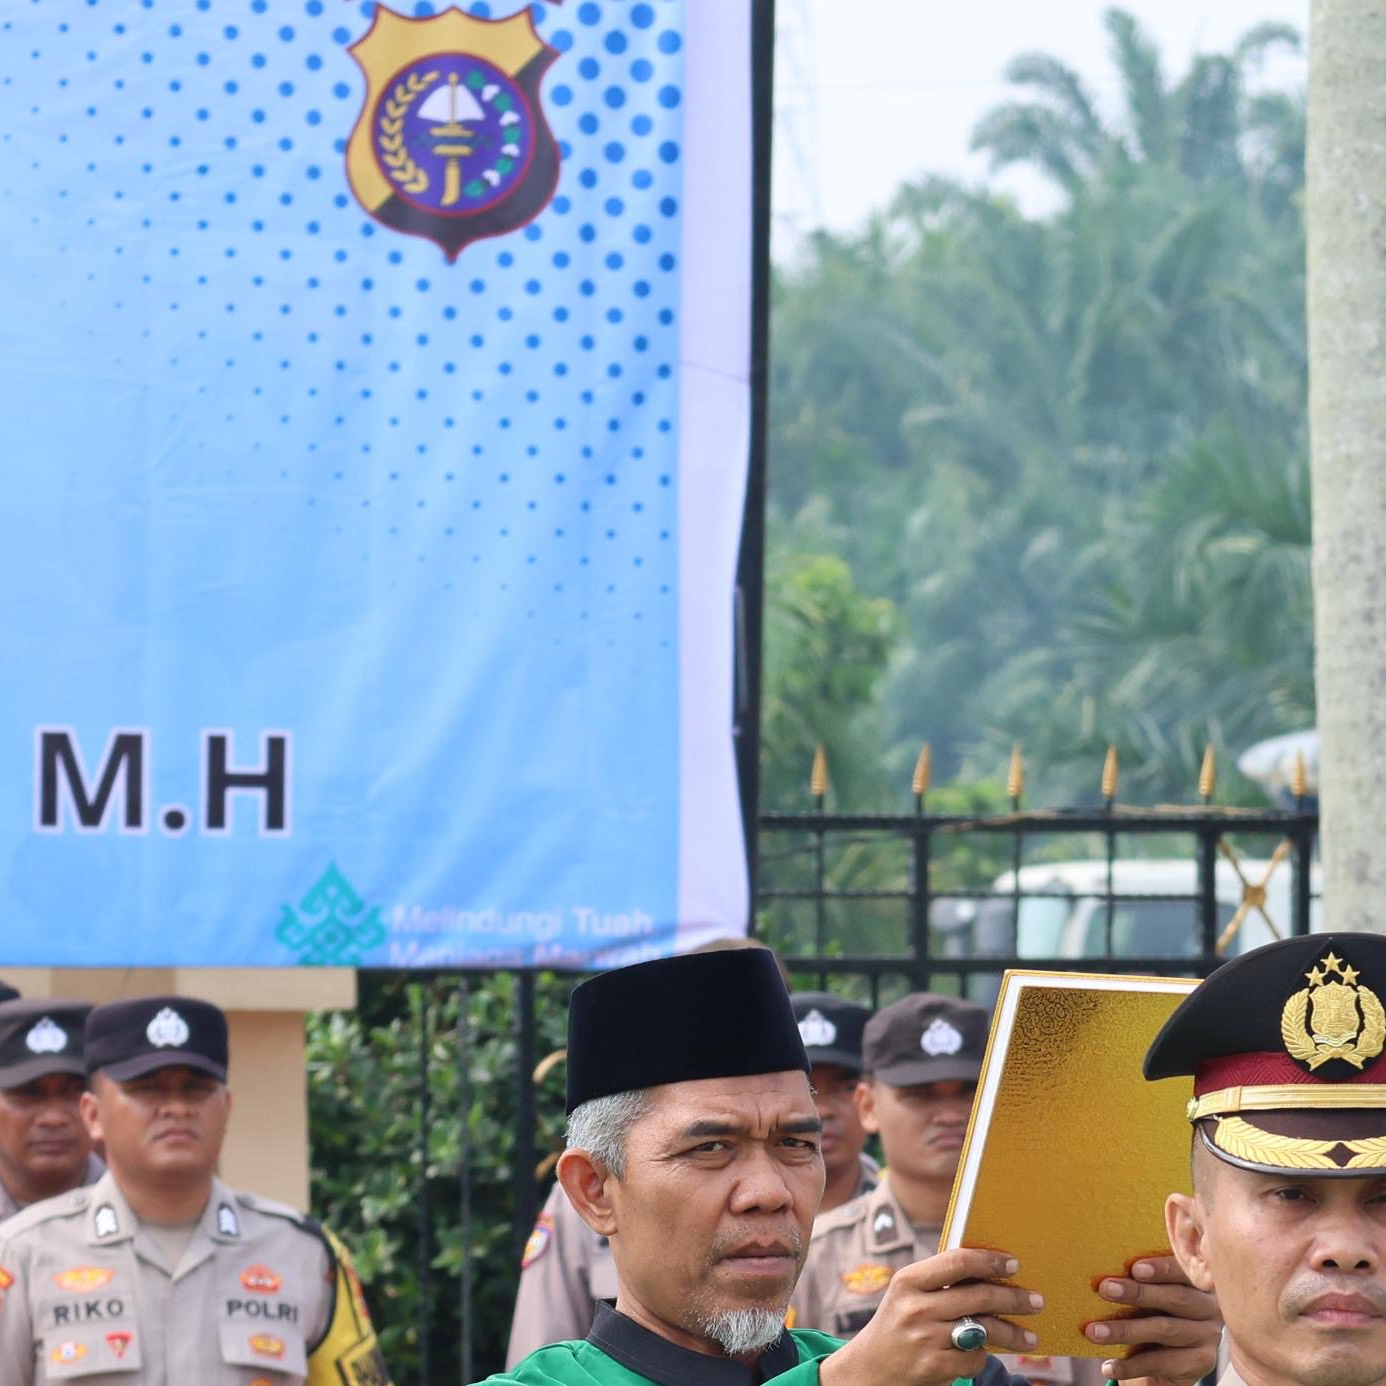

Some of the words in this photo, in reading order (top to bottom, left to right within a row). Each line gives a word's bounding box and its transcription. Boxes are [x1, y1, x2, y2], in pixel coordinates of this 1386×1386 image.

[40, 732, 287, 830] M.H
[53, 1300, 124, 1325] RIKO
[226, 1299, 299, 1323] POLRI
